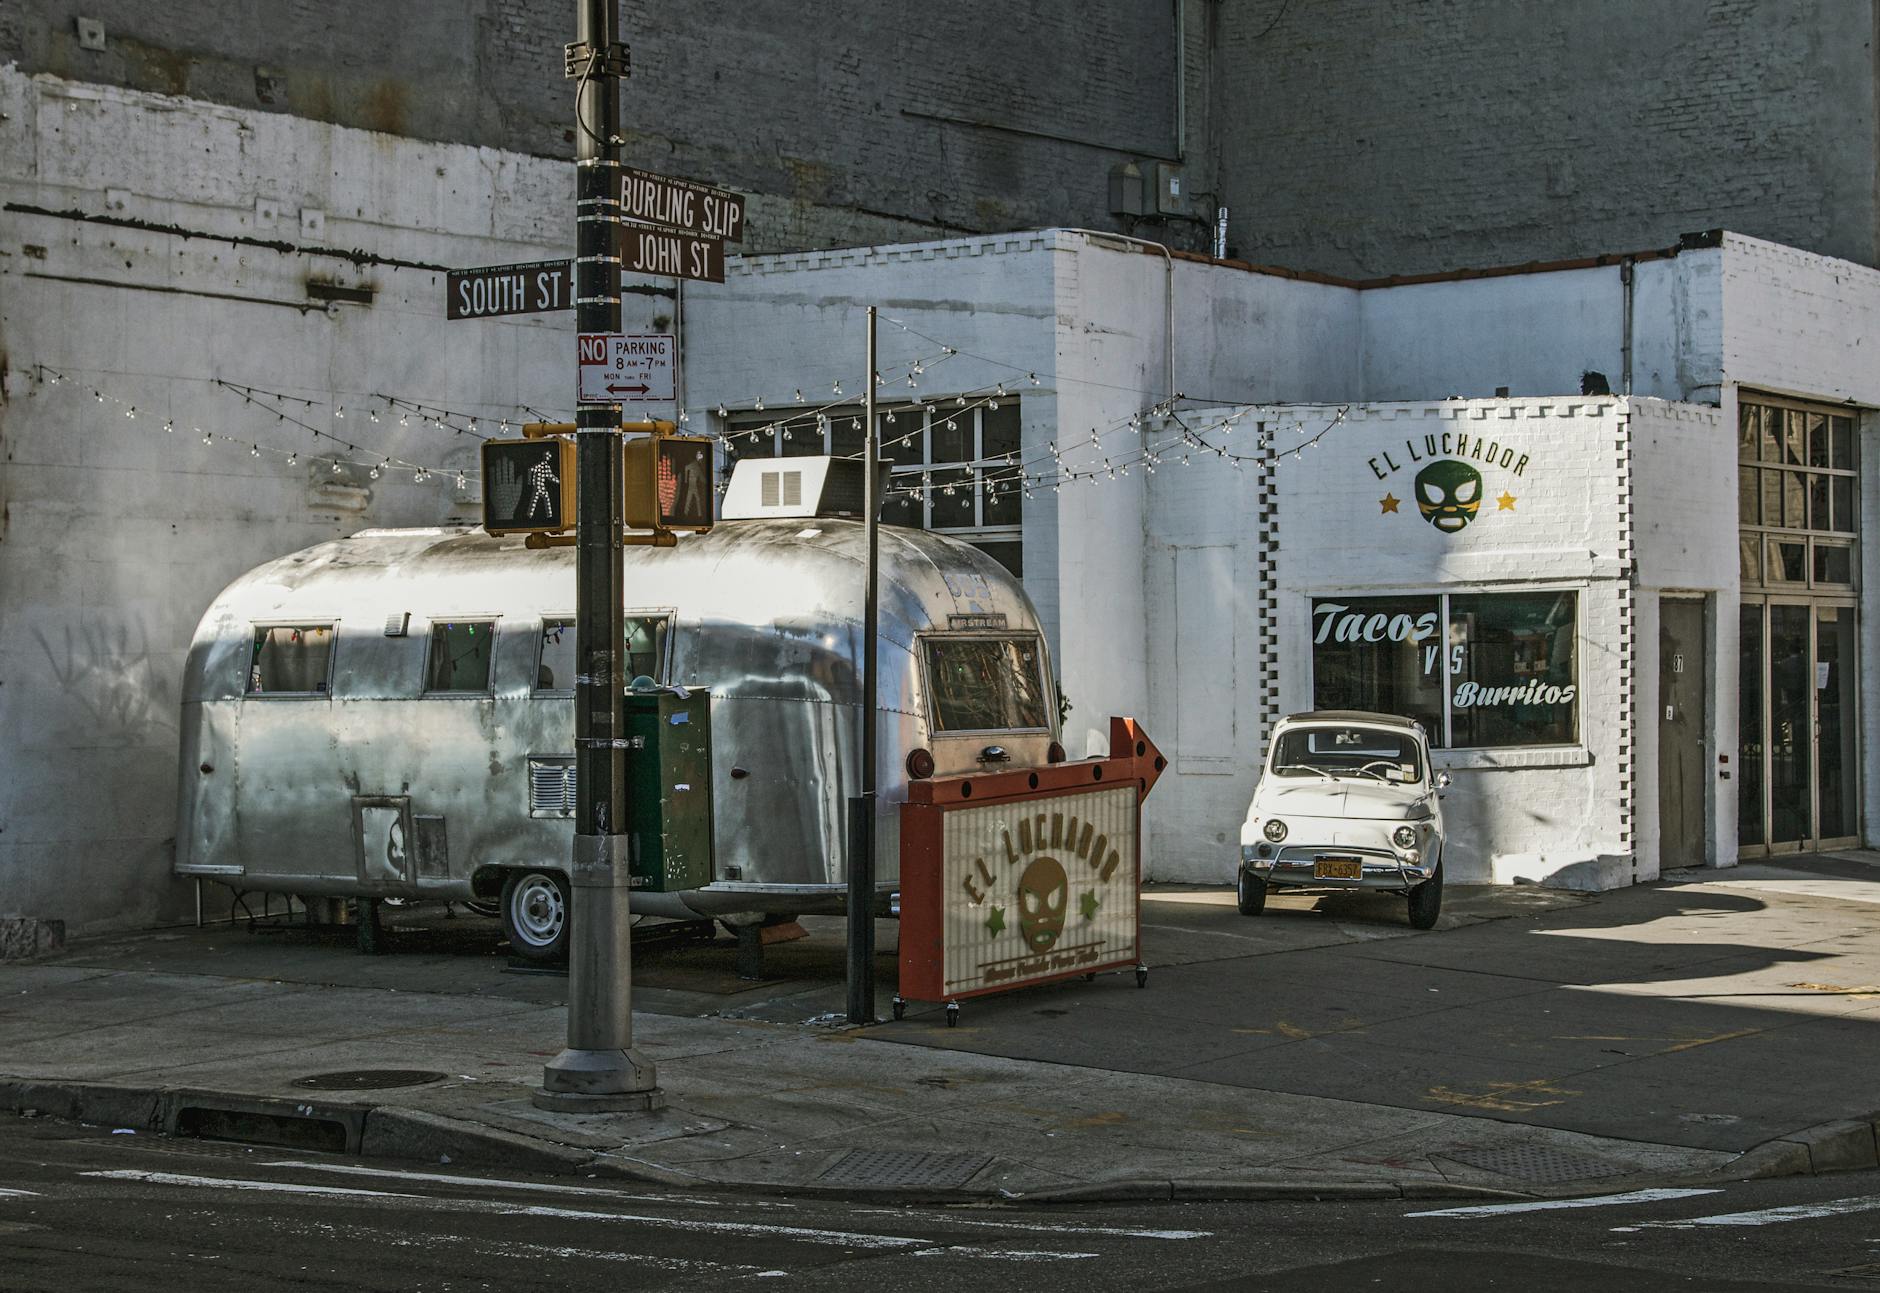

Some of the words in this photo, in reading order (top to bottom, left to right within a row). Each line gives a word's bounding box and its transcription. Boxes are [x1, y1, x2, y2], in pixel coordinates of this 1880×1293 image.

[621, 175, 694, 228] BURLING
[702, 196, 739, 237] SLIP
[633, 234, 681, 274] JOHN
[690, 241, 710, 278] ST
[460, 275, 525, 316] SOUTH
[536, 272, 562, 309] ST
[580, 339, 606, 361] NO
[616, 342, 665, 354] PARKING
[1368, 452, 1400, 480] EL
[1406, 432, 1529, 477] LUCHADOR
[1313, 603, 1438, 644] Tacos
[1452, 678, 1577, 708] Burritos
[963, 857, 997, 905] EL
